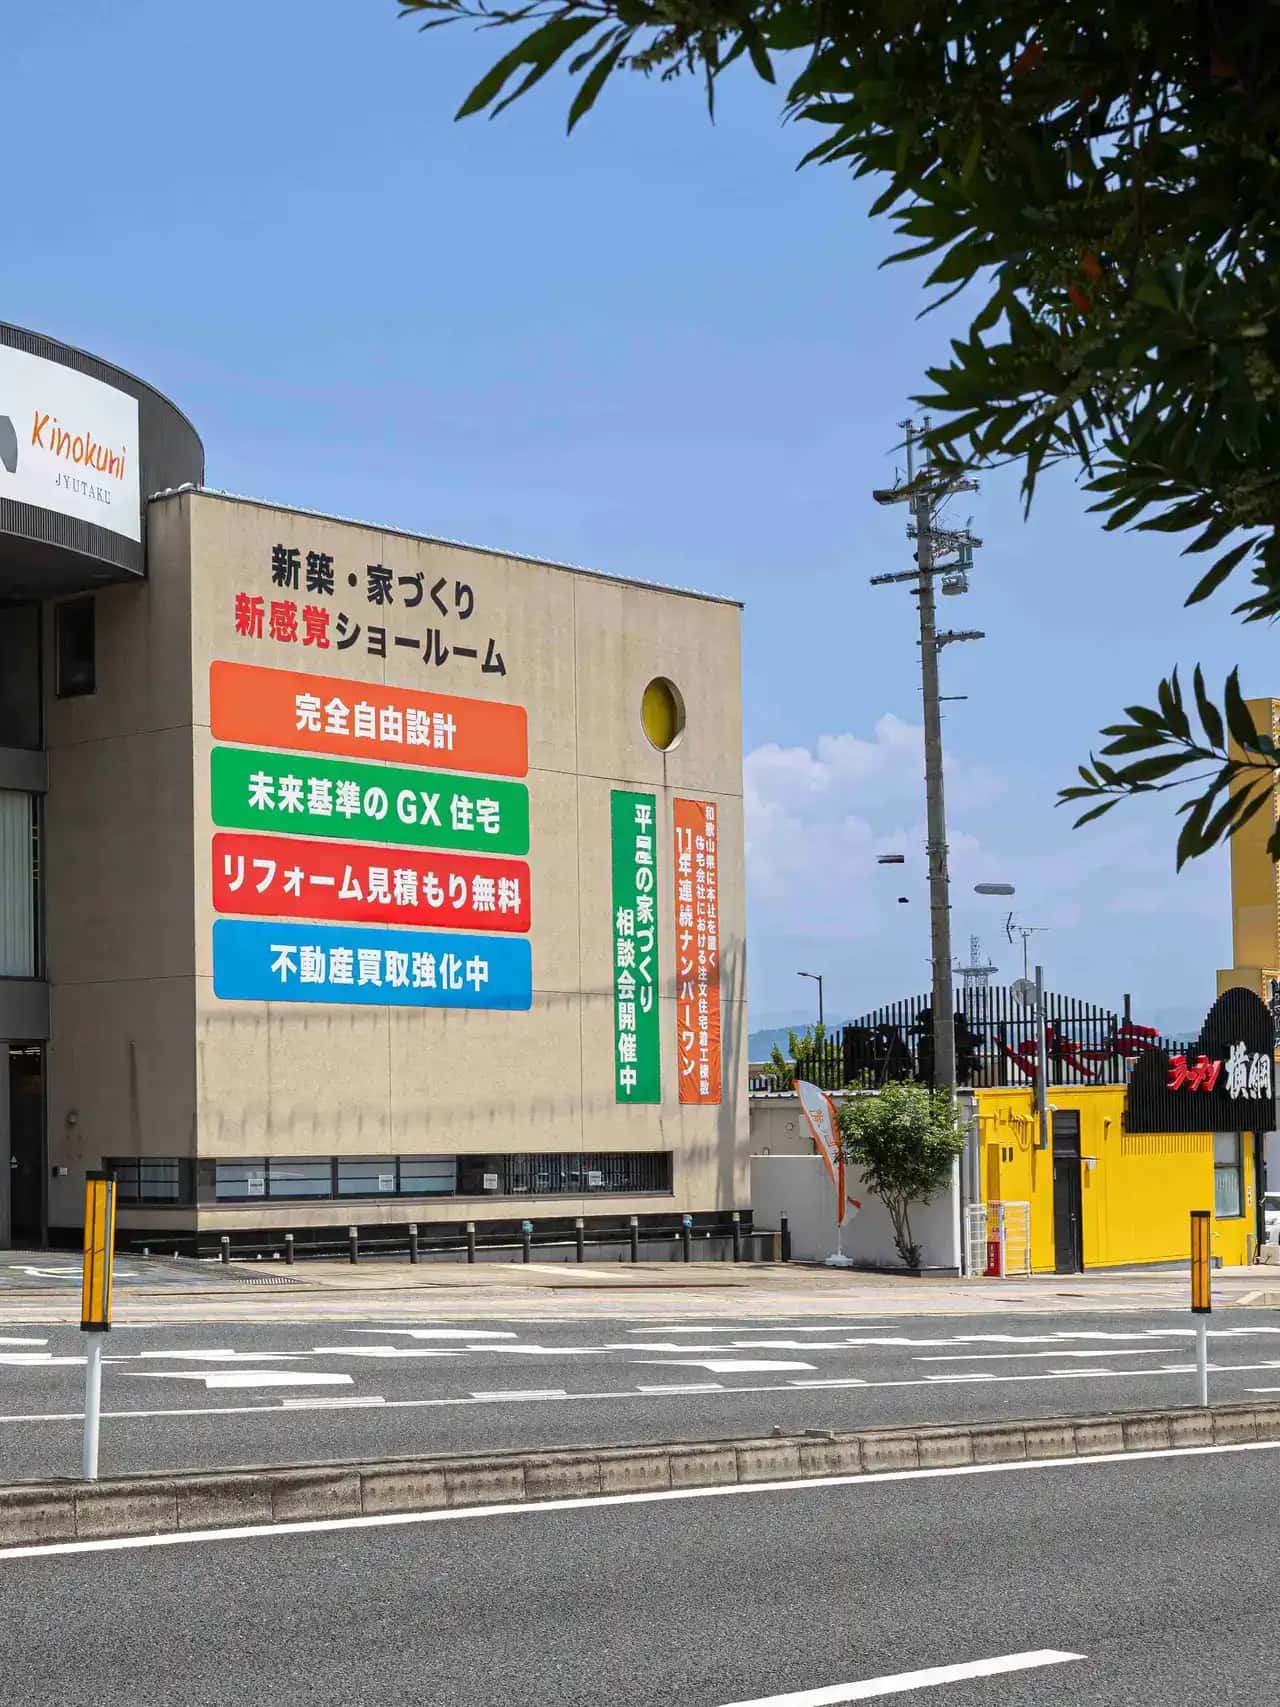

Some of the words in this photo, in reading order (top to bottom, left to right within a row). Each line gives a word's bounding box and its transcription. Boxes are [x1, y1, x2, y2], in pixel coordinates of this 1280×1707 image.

[32, 410, 126, 480] Kinokuni
[55, 472, 112, 505] JYUTAKU
[271, 543, 475, 621] 新築・家づくり
[234, 591, 507, 677] 新感覚ショールーム
[295, 692, 457, 751] 完全自由設計
[223, 854, 522, 915] リフォーム見積もり無料
[634, 803, 654, 1013] 平屋の家づくり
[270, 944, 489, 992] 不動産買取強化中
[616, 905, 637, 1095] 相談会開催中
